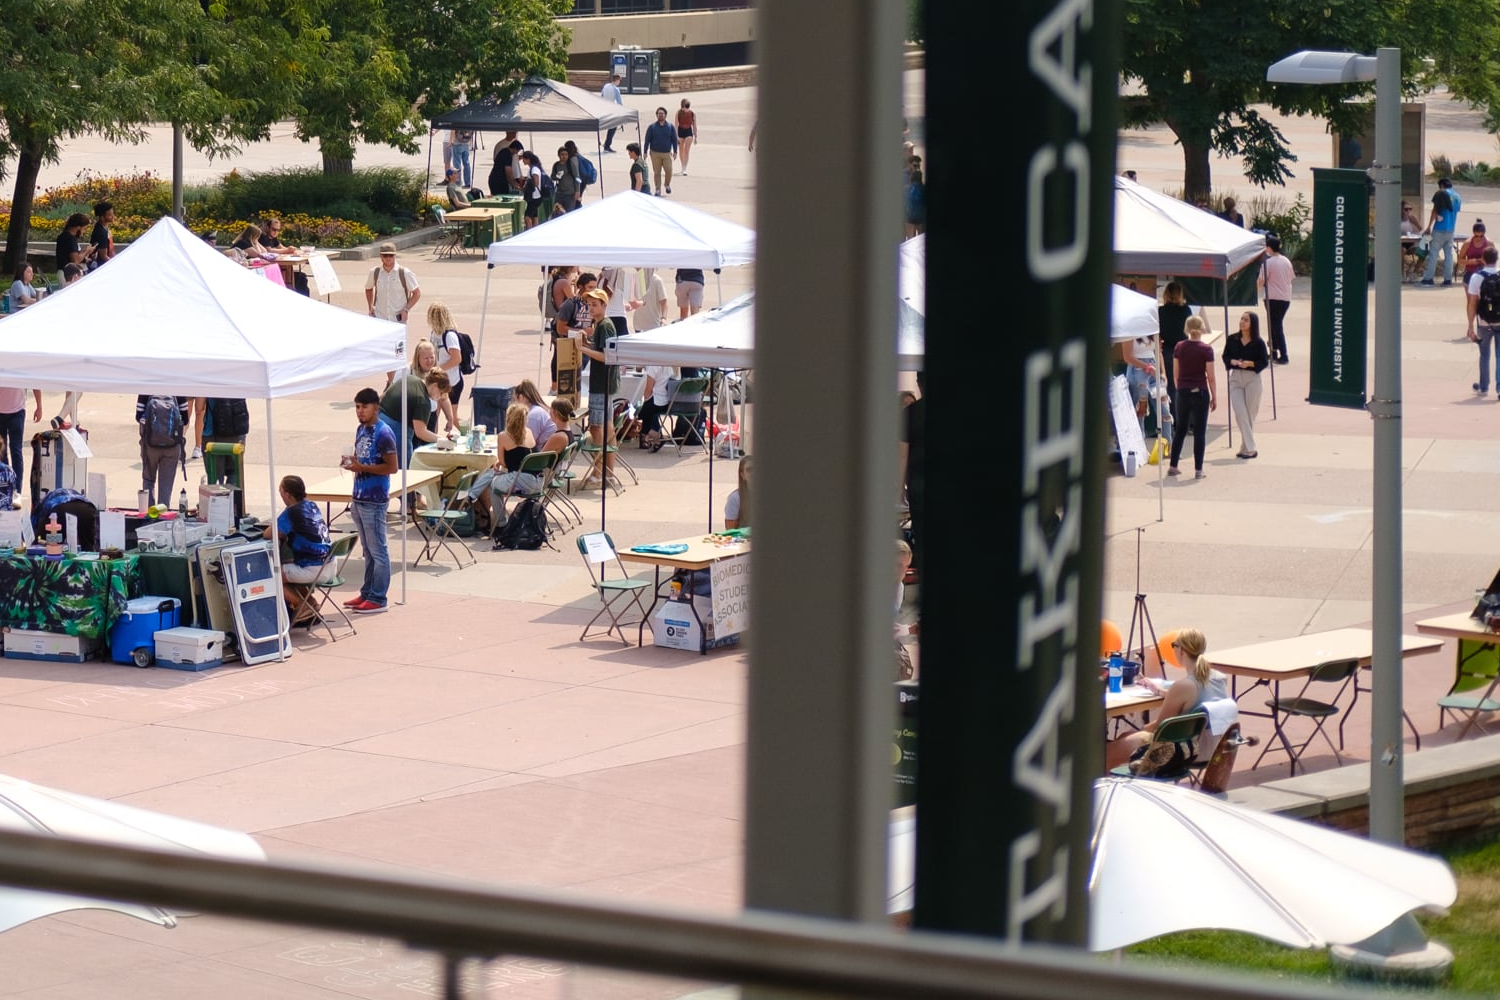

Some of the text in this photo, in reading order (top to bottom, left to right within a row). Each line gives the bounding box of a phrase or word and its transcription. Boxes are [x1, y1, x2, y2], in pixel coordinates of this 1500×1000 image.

[1333, 196, 1345, 382] COLORADO STATE UNIVERSITY
[719, 583, 749, 601] STUDE
[1007, 336, 1088, 950] TAKE
